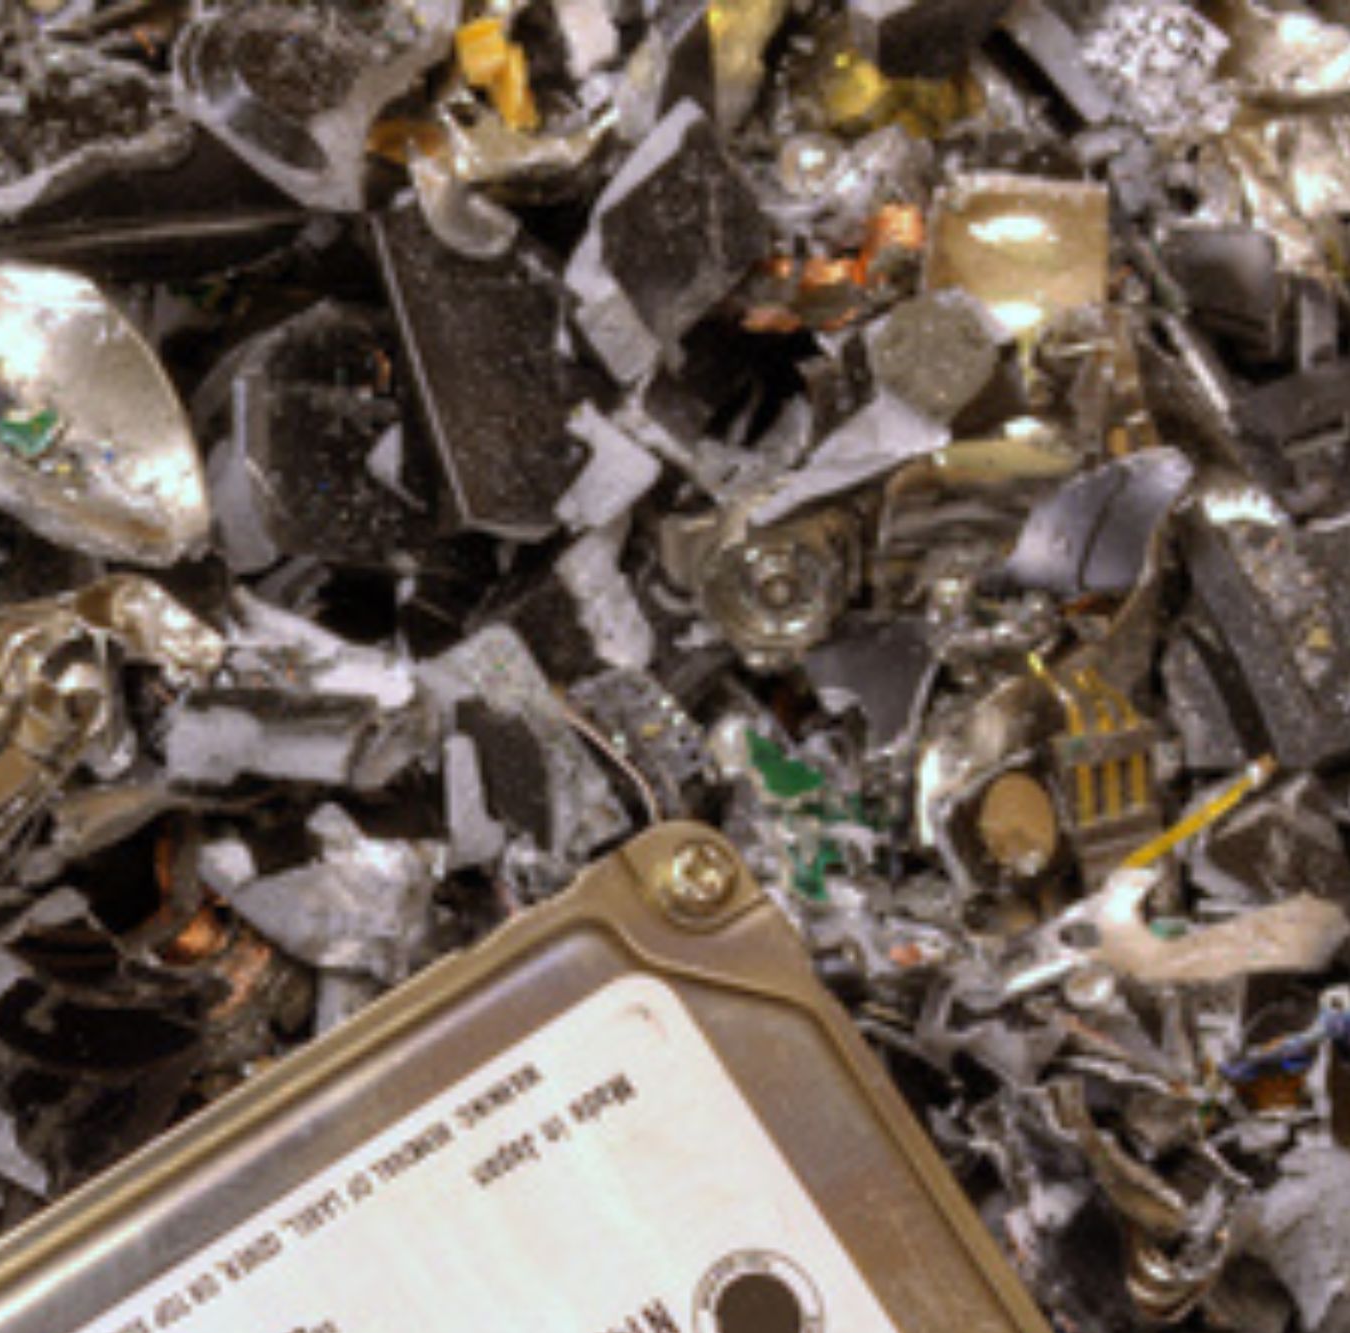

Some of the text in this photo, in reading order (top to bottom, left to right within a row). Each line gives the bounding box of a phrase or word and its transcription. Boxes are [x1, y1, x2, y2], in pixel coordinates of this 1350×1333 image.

[471, 1072, 636, 1188] Made in Japan
[346, 1171, 373, 1204] OF
